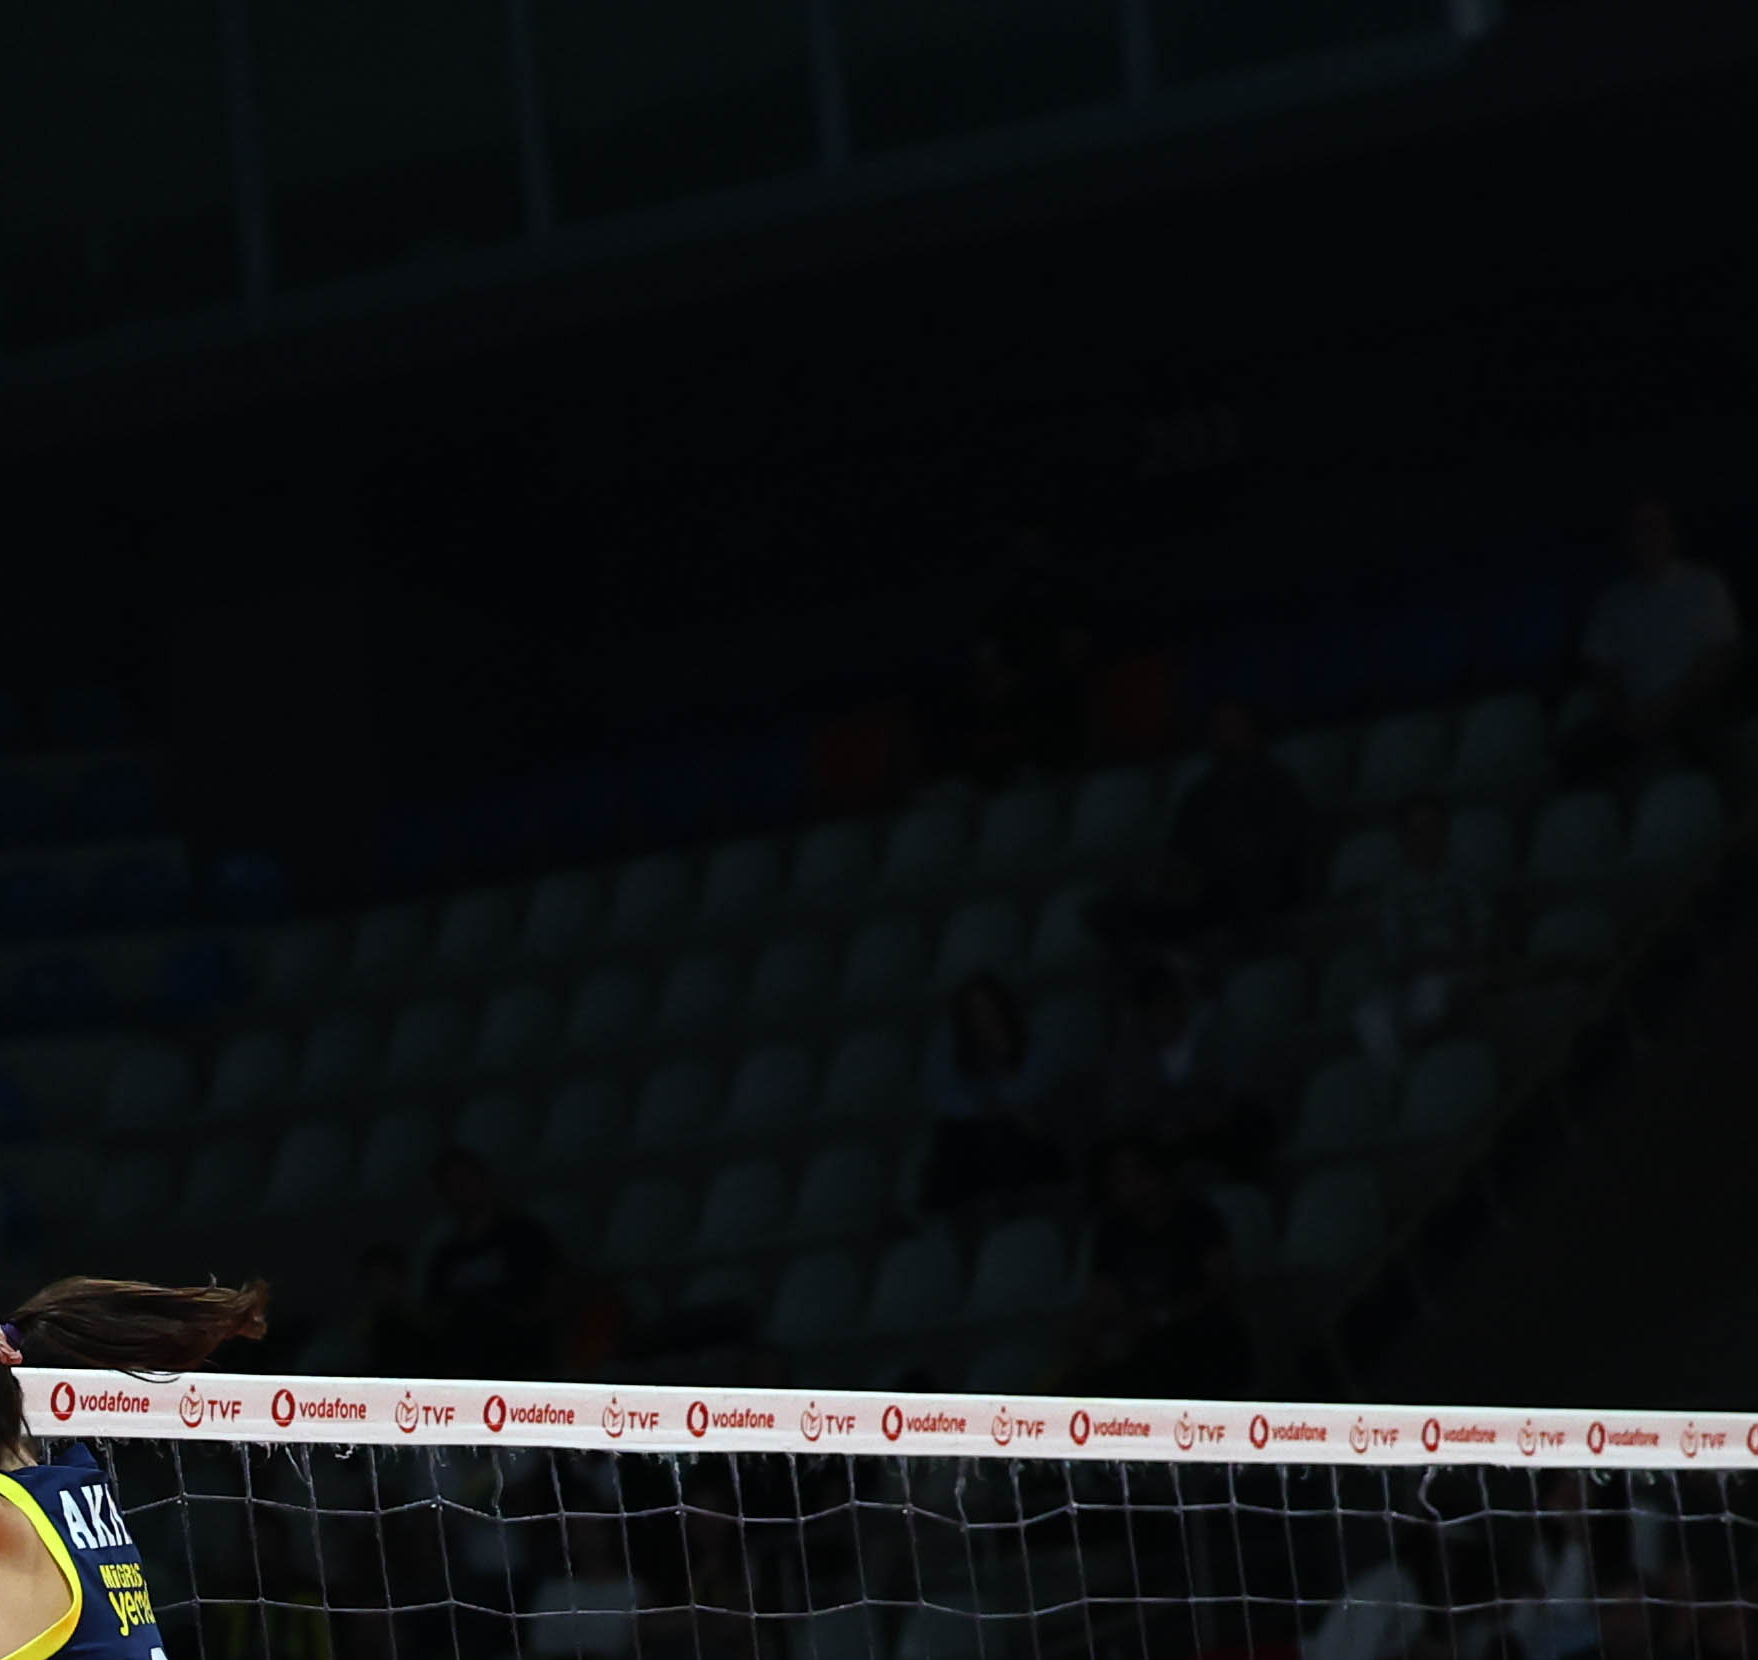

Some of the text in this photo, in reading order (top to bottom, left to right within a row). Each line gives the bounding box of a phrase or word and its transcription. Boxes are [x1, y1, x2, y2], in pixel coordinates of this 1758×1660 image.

[78, 1392, 152, 1413] vodafone
[204, 1400, 243, 1418] TVF
[298, 1399, 368, 1419] vodafone
[422, 1405, 457, 1423] TVF
[510, 1403, 576, 1424] vodafone
[628, 1411, 660, 1428] TVF
[711, 1409, 775, 1429] vodafone
[904, 1413, 968, 1432] vodafone
[824, 1415, 858, 1432] TVF
[1018, 1418, 1047, 1435] TVF
